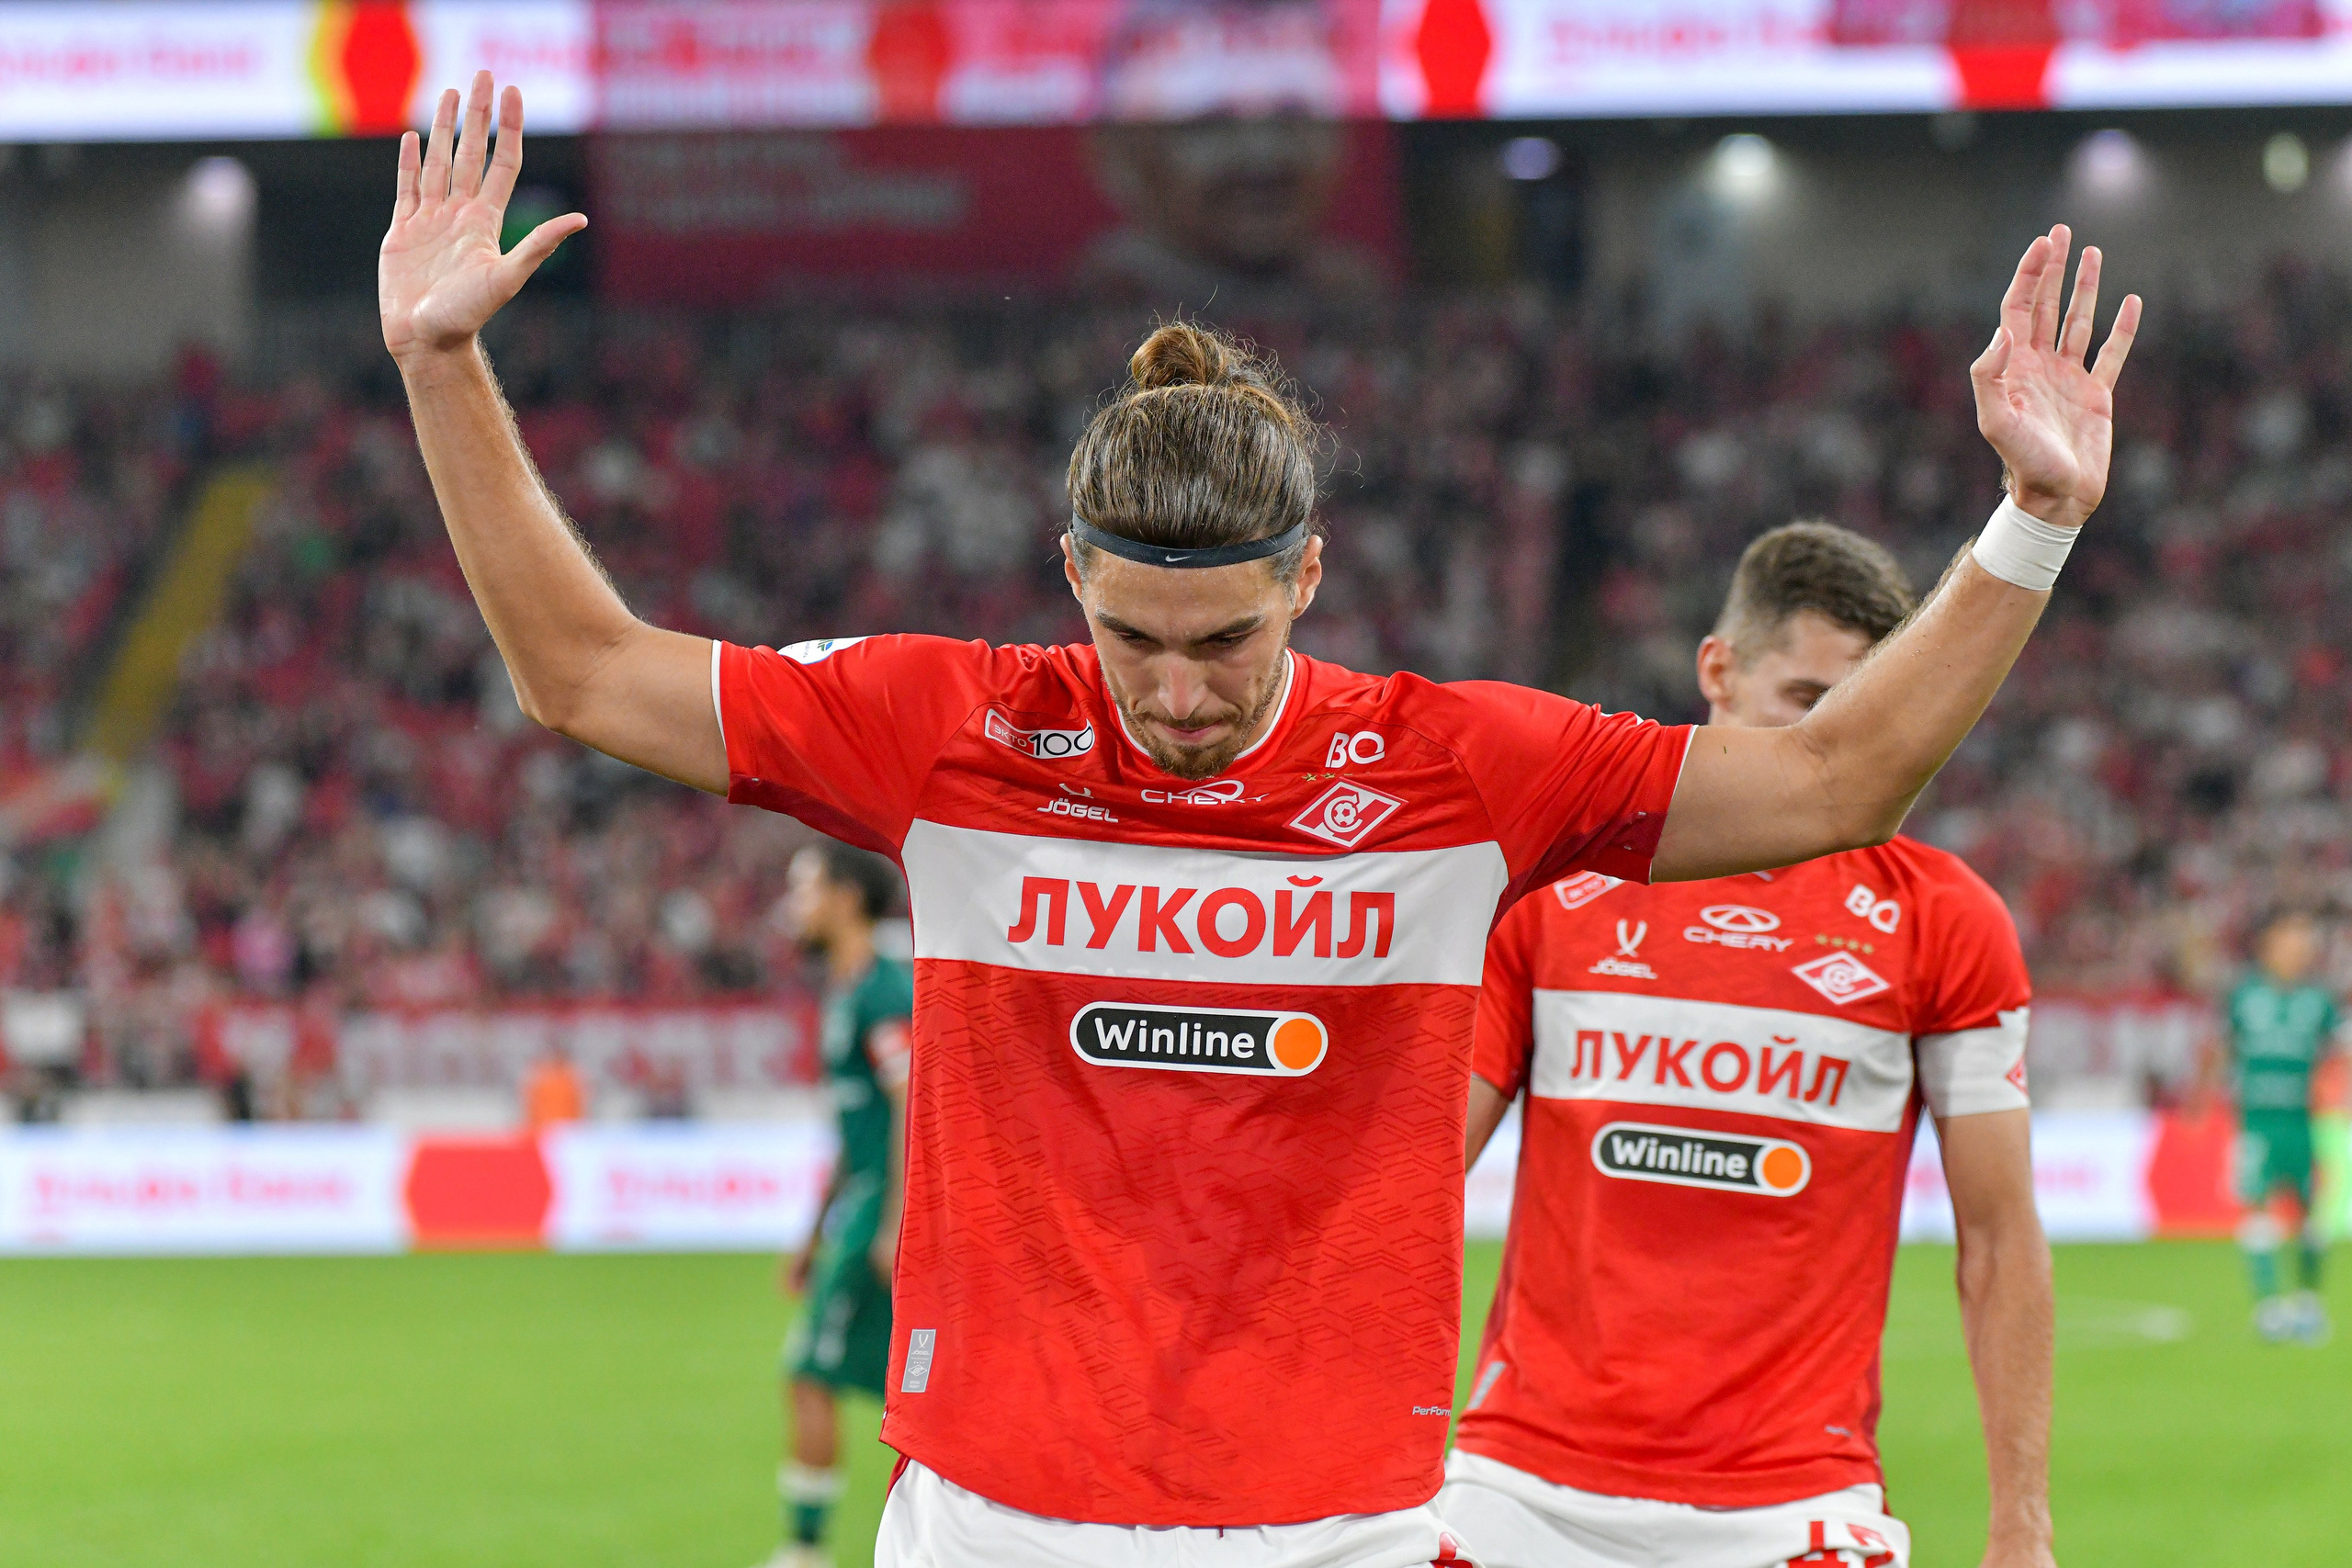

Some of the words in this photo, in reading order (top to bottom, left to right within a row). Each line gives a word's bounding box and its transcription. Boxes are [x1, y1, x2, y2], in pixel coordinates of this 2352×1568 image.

[994, 725, 1027, 747] ЭКТО
[1029, 726, 1093, 756] 100
[1036, 797, 1119, 824] JÖGEL
[1007, 874, 1396, 958] ЛУКОЙЛ
[1683, 926, 1794, 953] CHERY
[1094, 1017, 1255, 1059] Winline
[1570, 1030, 1850, 1107] ЛУКОЙЛ
[1611, 1135, 1748, 1179] Winline
